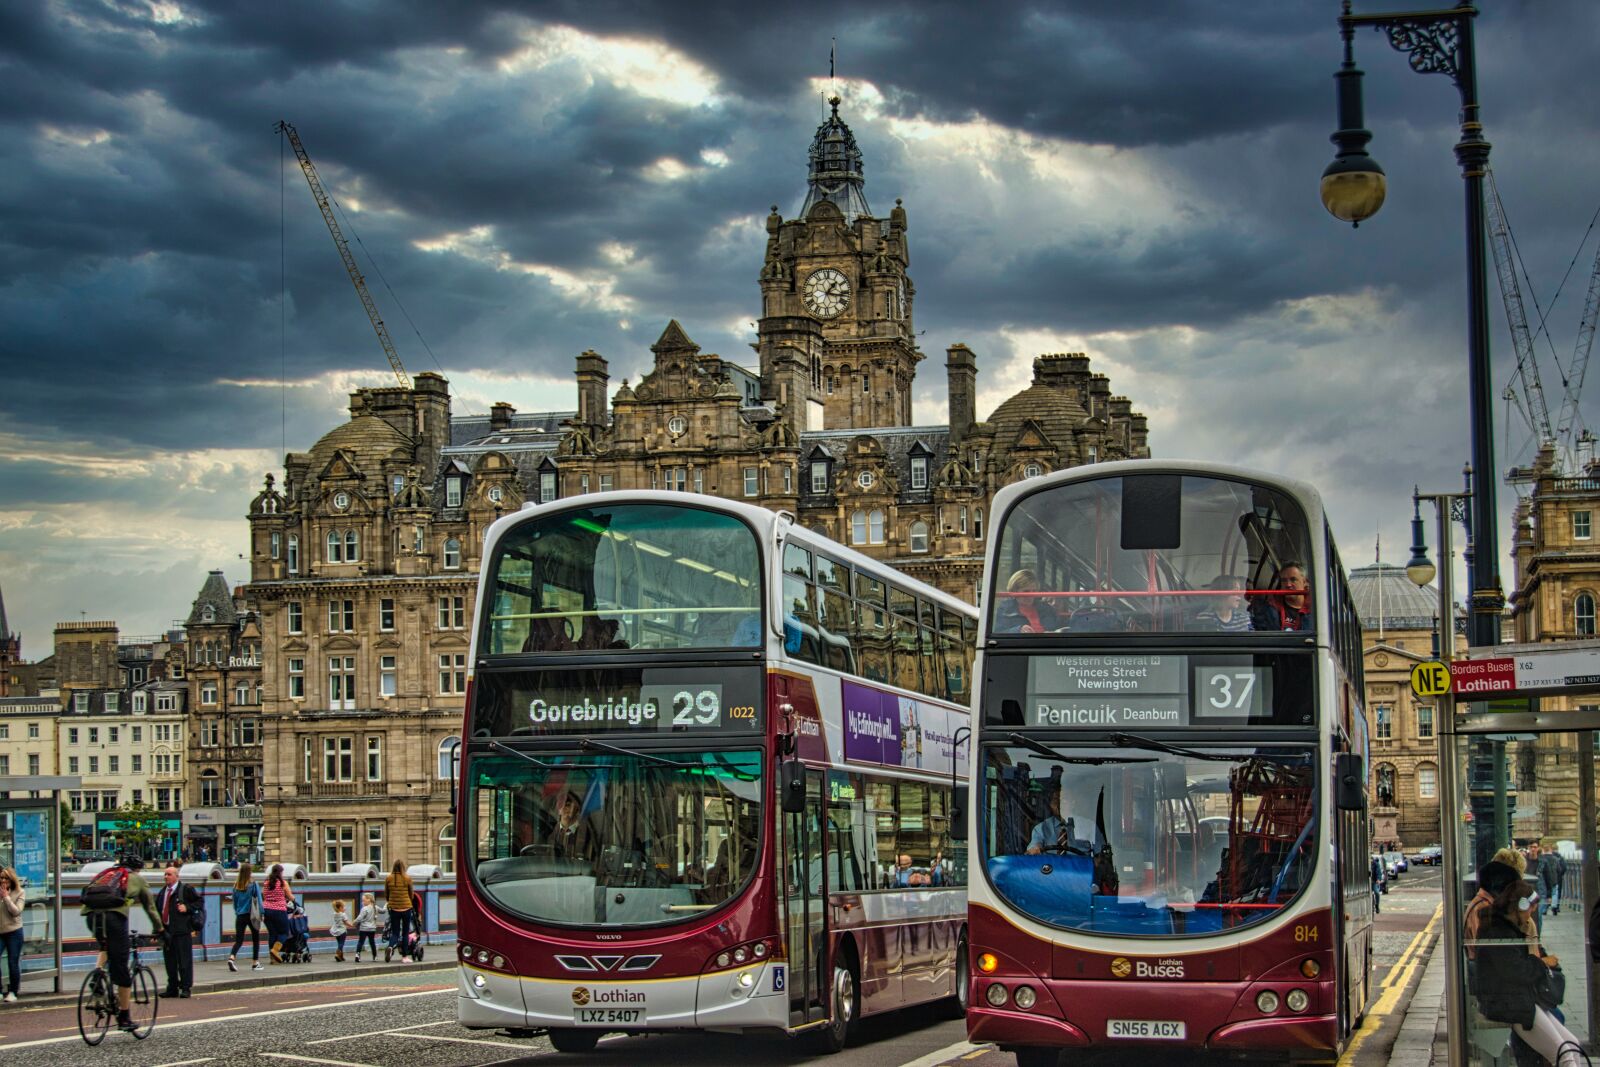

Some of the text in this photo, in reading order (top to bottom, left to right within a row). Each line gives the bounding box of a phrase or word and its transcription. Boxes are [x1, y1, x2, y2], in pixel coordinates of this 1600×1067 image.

[230, 656, 258, 667] ROYAL
[1056, 656, 1100, 666] Western
[1104, 656, 1148, 666] General
[1452, 662, 1514, 674] Borders Buses
[1068, 667, 1147, 677] Princes Street
[1078, 678, 1138, 690] Newington
[1418, 668, 1444, 692] NE
[1457, 678, 1510, 692] Lothian
[1210, 674, 1256, 708] 37
[530, 697, 656, 724] Gorebridge
[672, 690, 720, 724] 29
[730, 707, 755, 719] 1022
[1037, 704, 1178, 724] Penicuik Deanburn
[801, 716, 819, 736] Lothian
[848, 710, 858, 739] My
[858, 712, 882, 743] Edinburgh
[1294, 926, 1318, 942] 814
[1136, 962, 1184, 978] Buses
[593, 989, 646, 1002] Lothian
[581, 1010, 640, 1022] LXZ 5407
[1113, 1022, 1180, 1036] SN56 AGX
